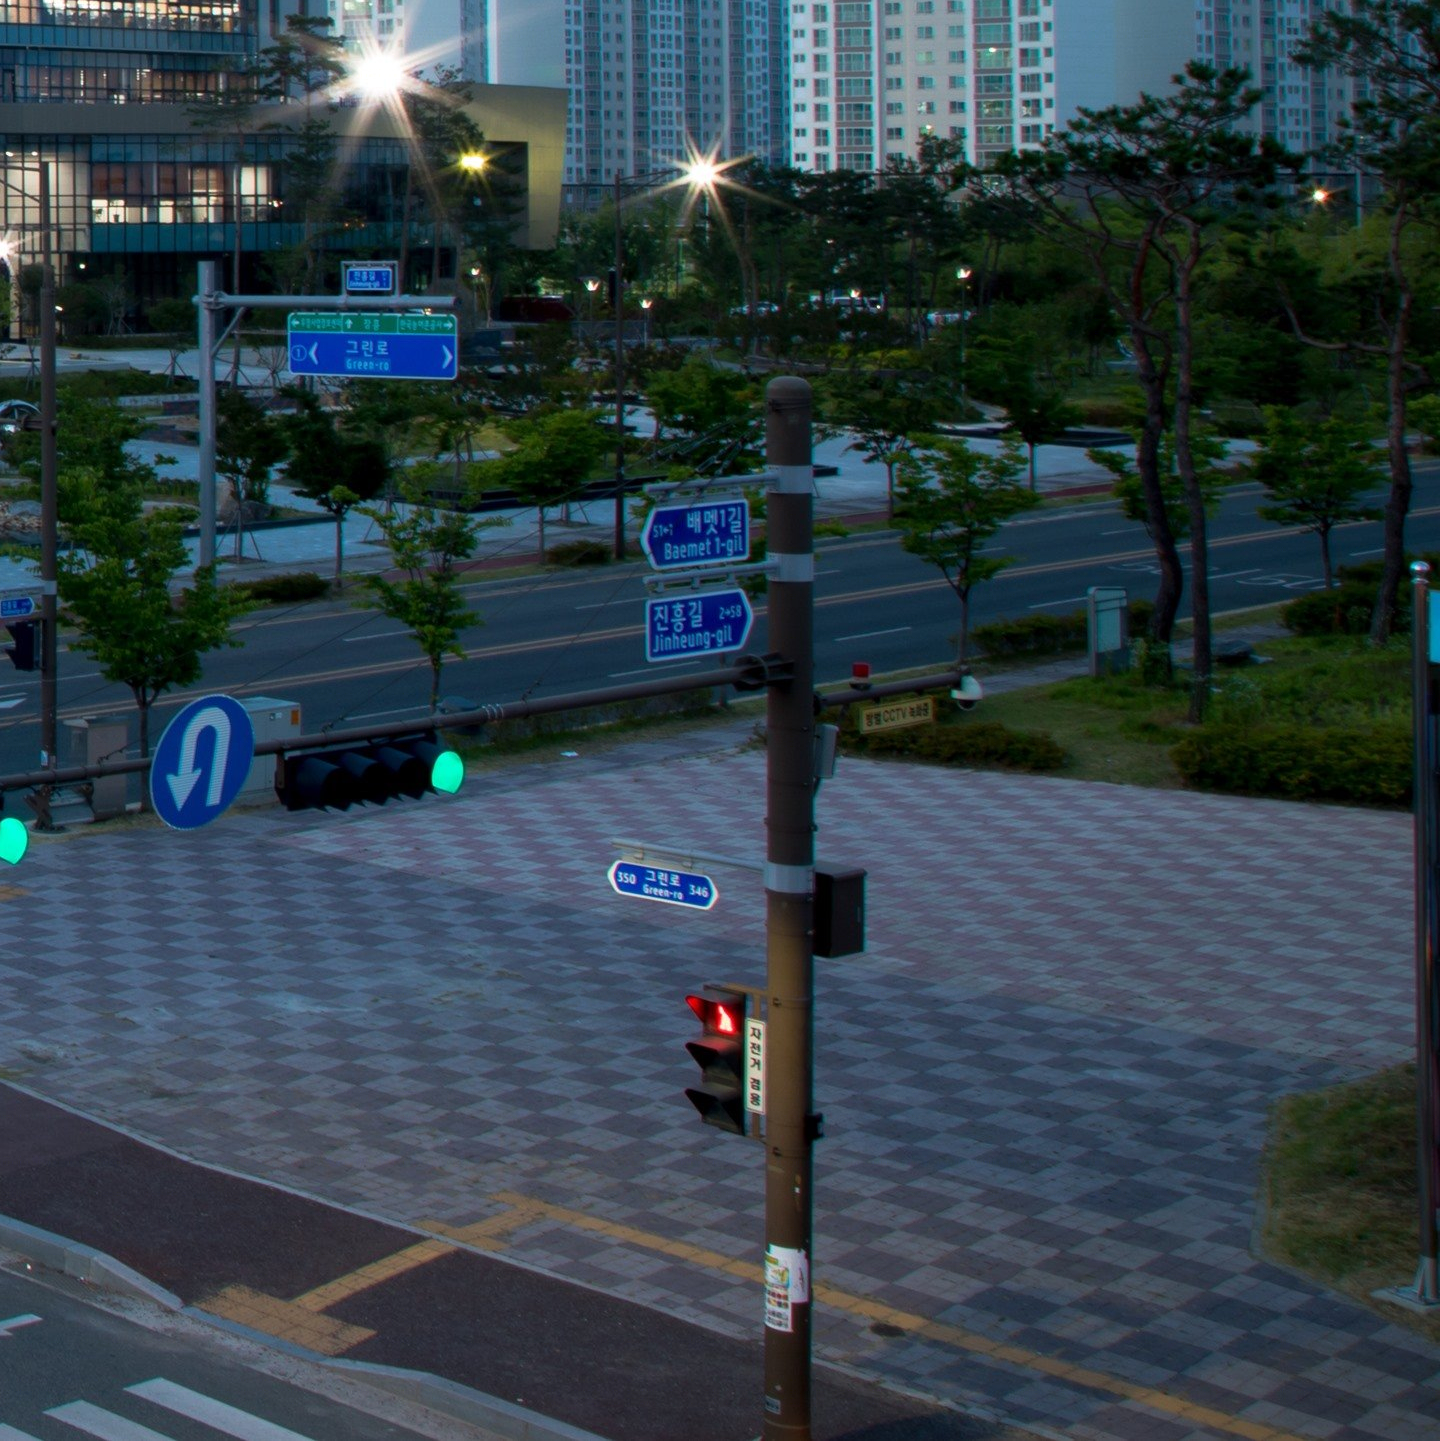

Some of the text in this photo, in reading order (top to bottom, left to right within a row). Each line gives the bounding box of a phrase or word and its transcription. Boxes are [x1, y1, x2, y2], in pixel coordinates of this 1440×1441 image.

[346, 339, 390, 358] 그린로
[346, 359, 390, 371] Green-ro
[687, 505, 743, 536] 배멧1길
[663, 533, 744, 560] Baemet 1-gil
[653, 600, 703, 633] 진흥길
[652, 625, 733, 654] Jinheung-gil
[866, 713, 881, 727] 방범
[883, 708, 906, 723] CCTV
[617, 871, 638, 885] 350
[645, 869, 682, 887] 그린로
[642, 883, 685, 901] Green-ro
[689, 884, 711, 899] 346
[750, 1027, 762, 1107] 자전거 겸용
